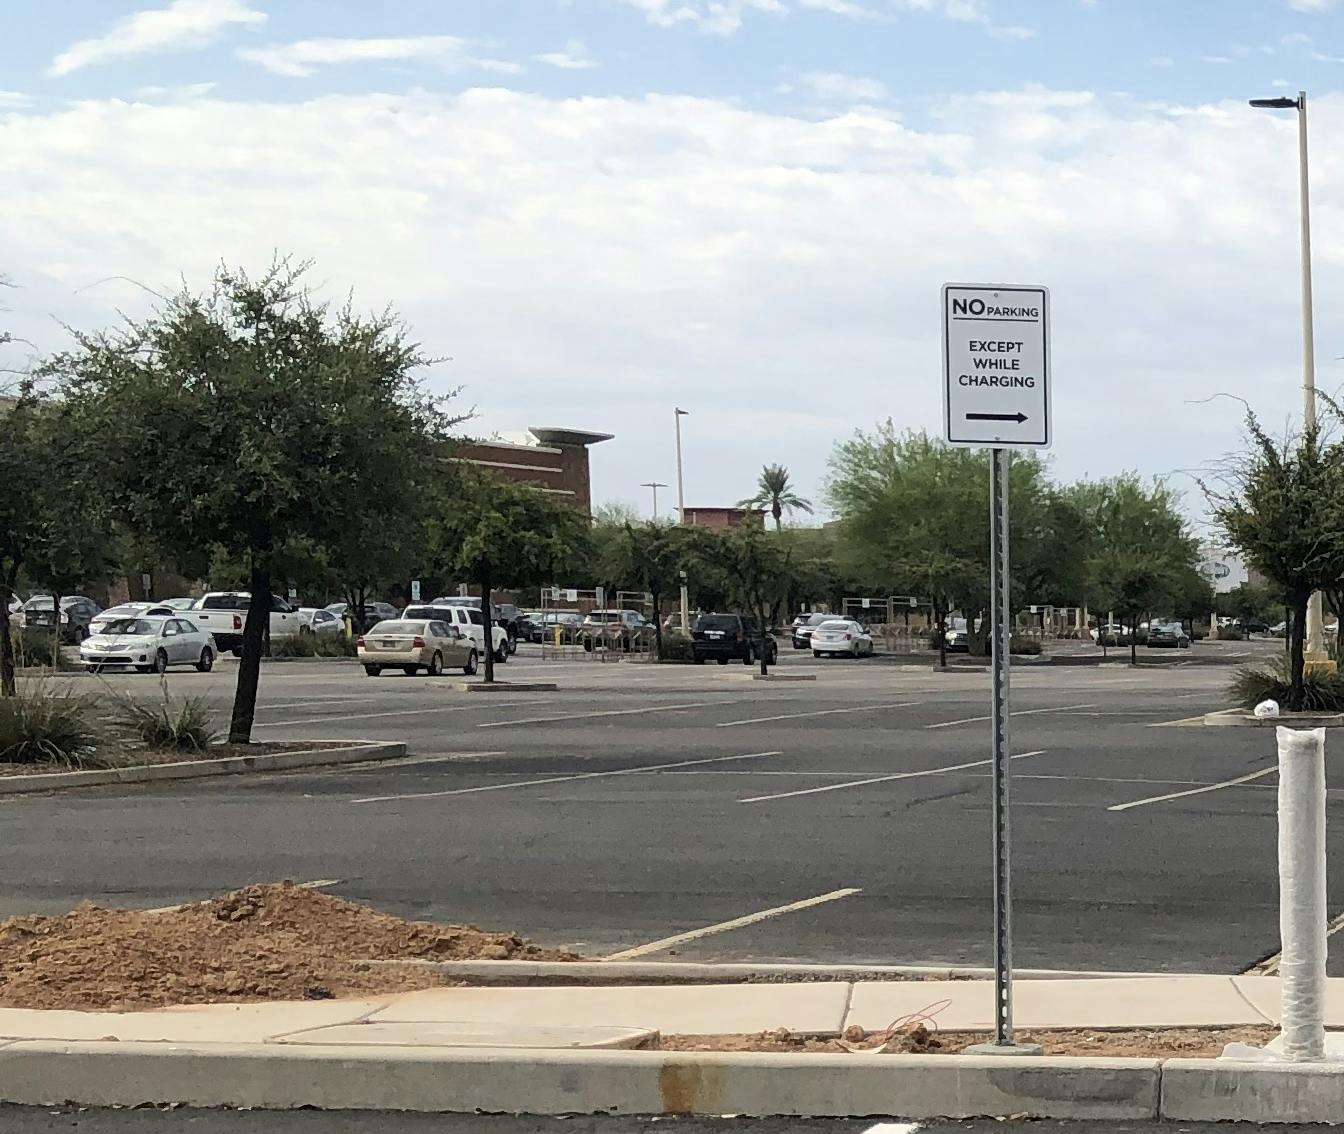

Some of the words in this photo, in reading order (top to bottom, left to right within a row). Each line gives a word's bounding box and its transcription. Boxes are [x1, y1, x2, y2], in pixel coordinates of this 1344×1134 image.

[952, 298, 986, 315] NO
[986, 306, 1039, 318] PARKING
[969, 340, 1024, 353] EXCEPT
[973, 358, 1021, 370] WHILE
[958, 374, 1036, 388] CHARGING
